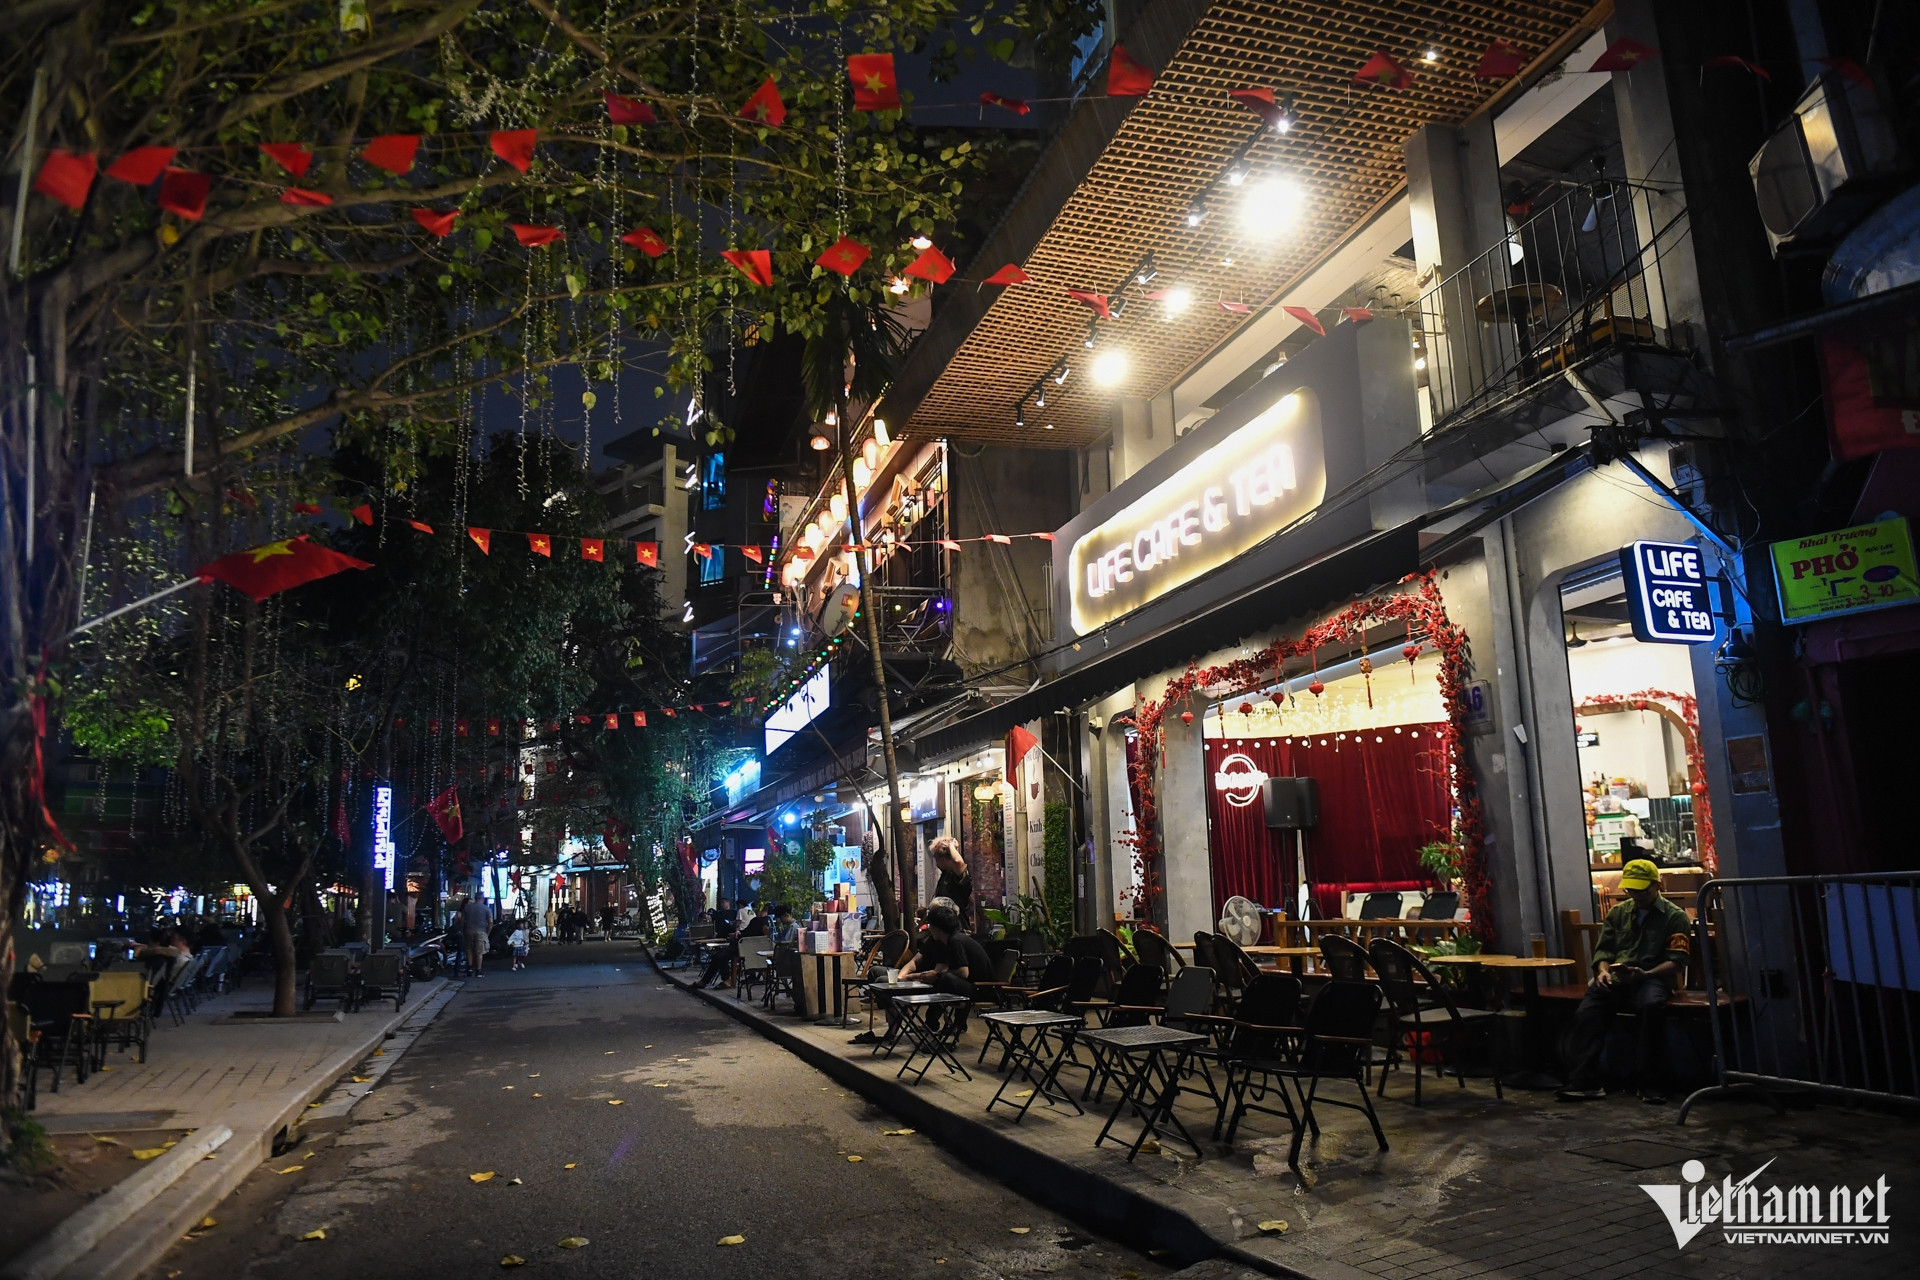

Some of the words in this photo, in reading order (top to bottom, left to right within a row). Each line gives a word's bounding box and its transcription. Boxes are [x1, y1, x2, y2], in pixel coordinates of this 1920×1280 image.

[1087, 541, 1134, 598] LIFE
[1133, 500, 1202, 571] CAFE
[1203, 486, 1230, 532] &
[1229, 443, 1297, 516] TEA
[1799, 534, 1828, 549] Khai
[1646, 549, 1700, 579] LIFE
[1790, 543, 1859, 580] PHỞ
[1652, 588, 1693, 609] CAFE
[1667, 613, 1681, 629] &
[1682, 612, 1711, 630] TEA
